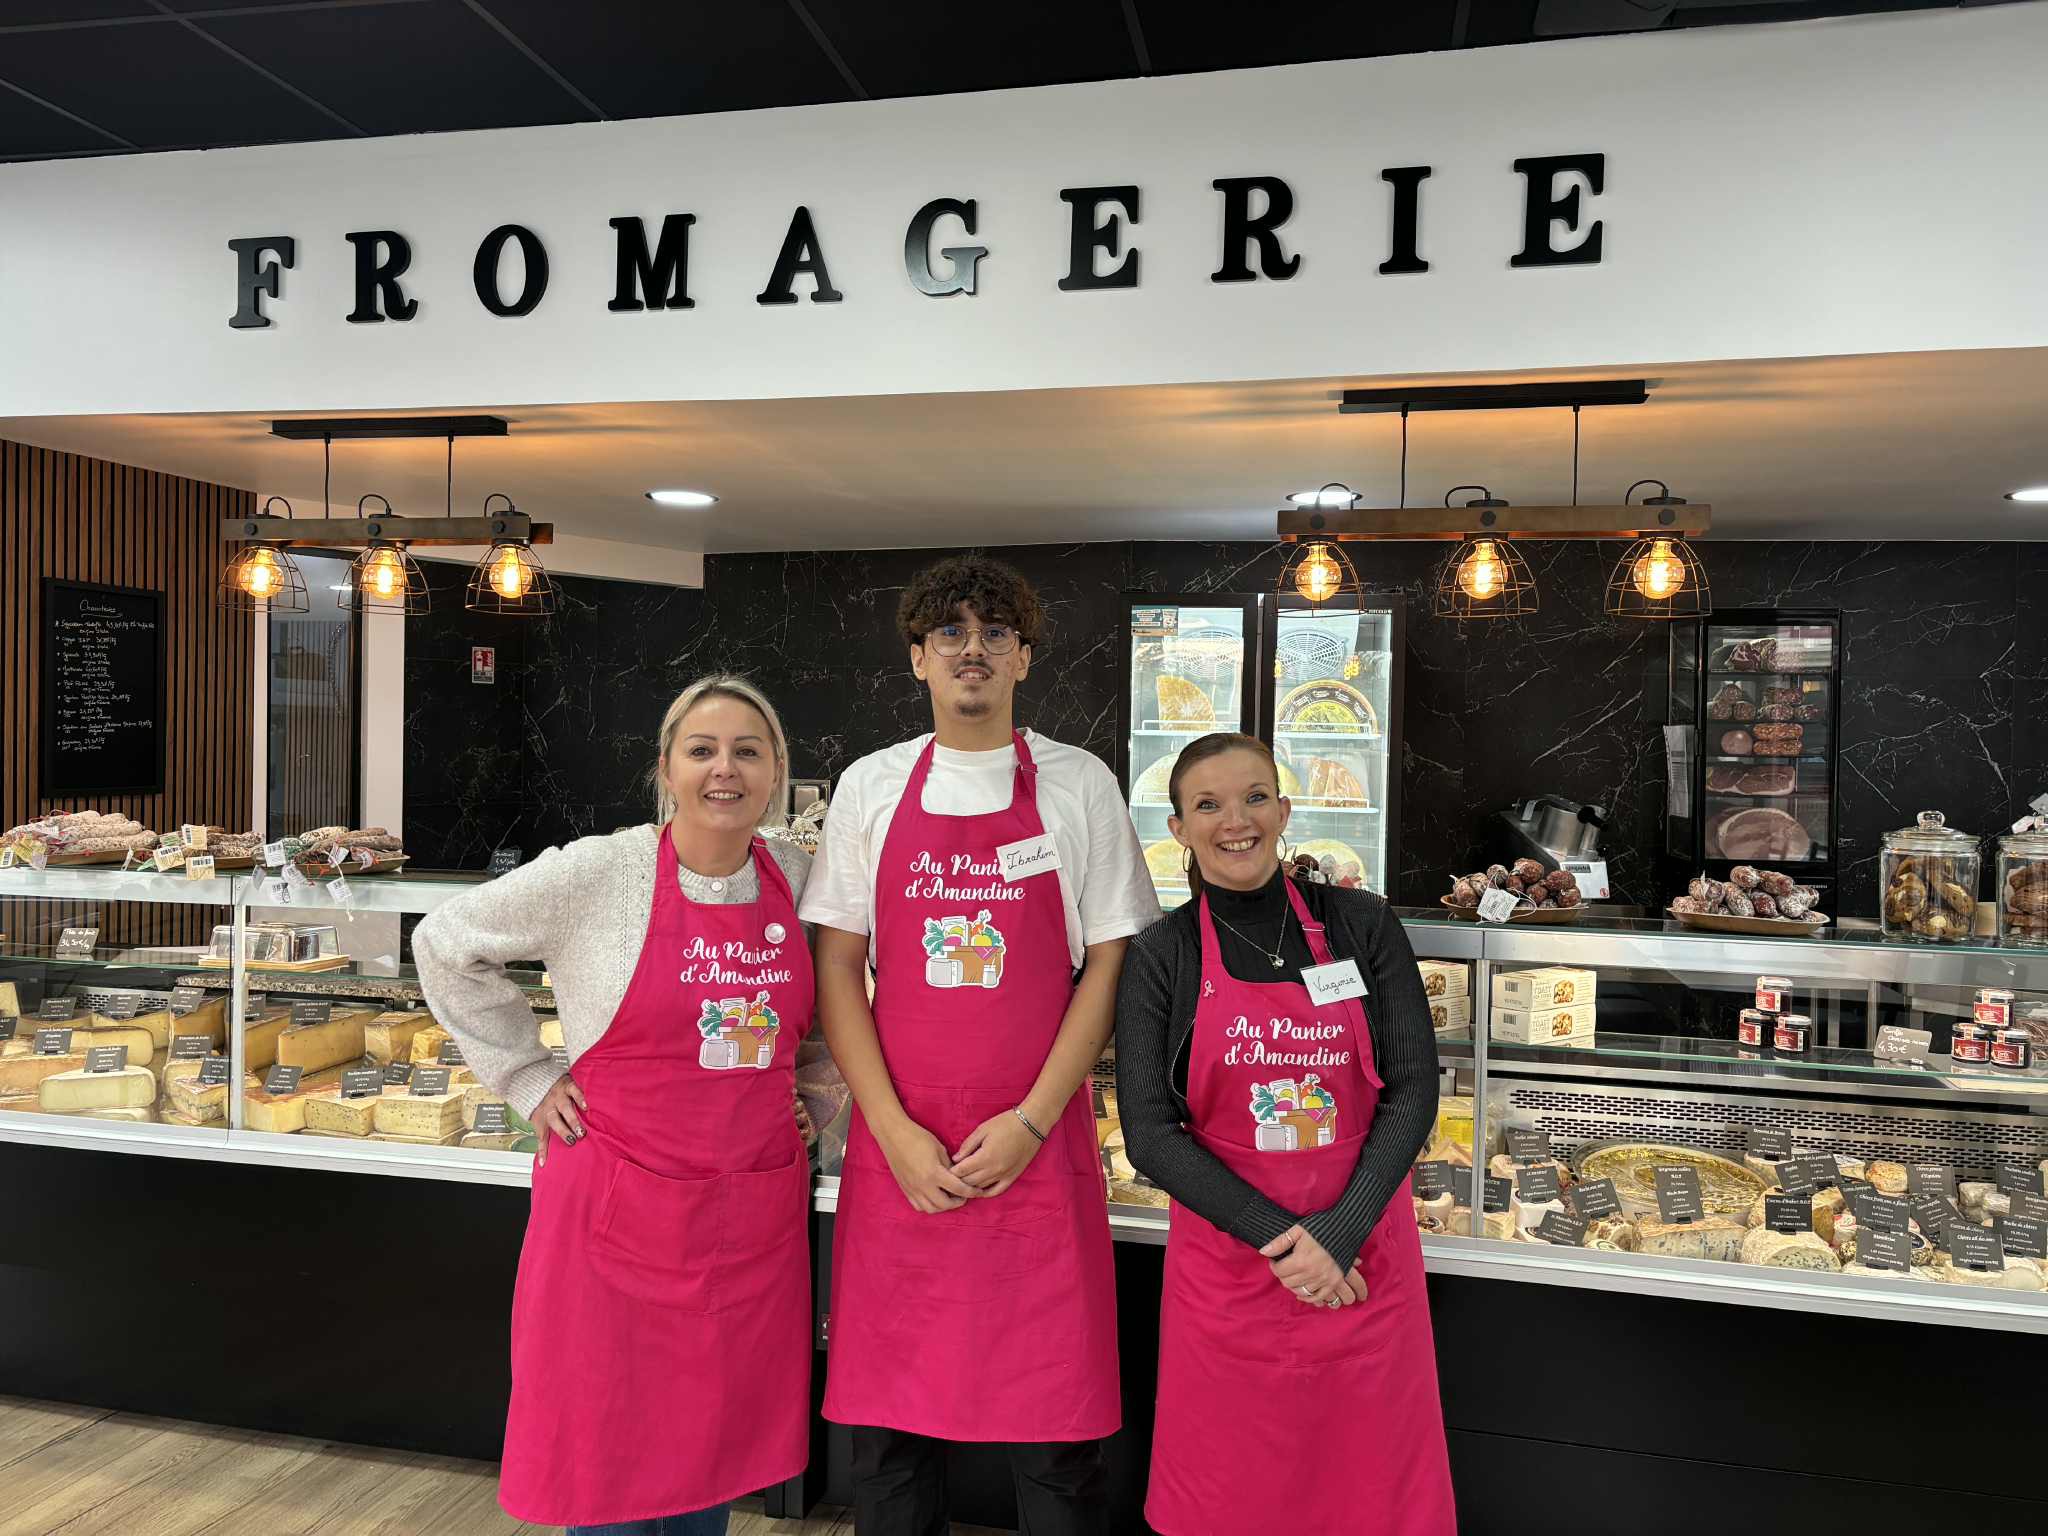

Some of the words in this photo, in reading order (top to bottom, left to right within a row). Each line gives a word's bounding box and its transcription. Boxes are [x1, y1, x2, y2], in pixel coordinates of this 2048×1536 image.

[228, 153, 1605, 329] FROMAGERIE
[909, 851, 945, 875] Au
[950, 854, 1000, 876] Pani
[1006, 846, 1056, 870] Ibrahim
[905, 876, 1026, 902] d'Amandine
[683, 936, 721, 960] Au
[1225, 1015, 1264, 1040] Au
[1269, 1017, 1345, 1041] Panier
[1224, 1040, 1350, 1067] d'Amandine
